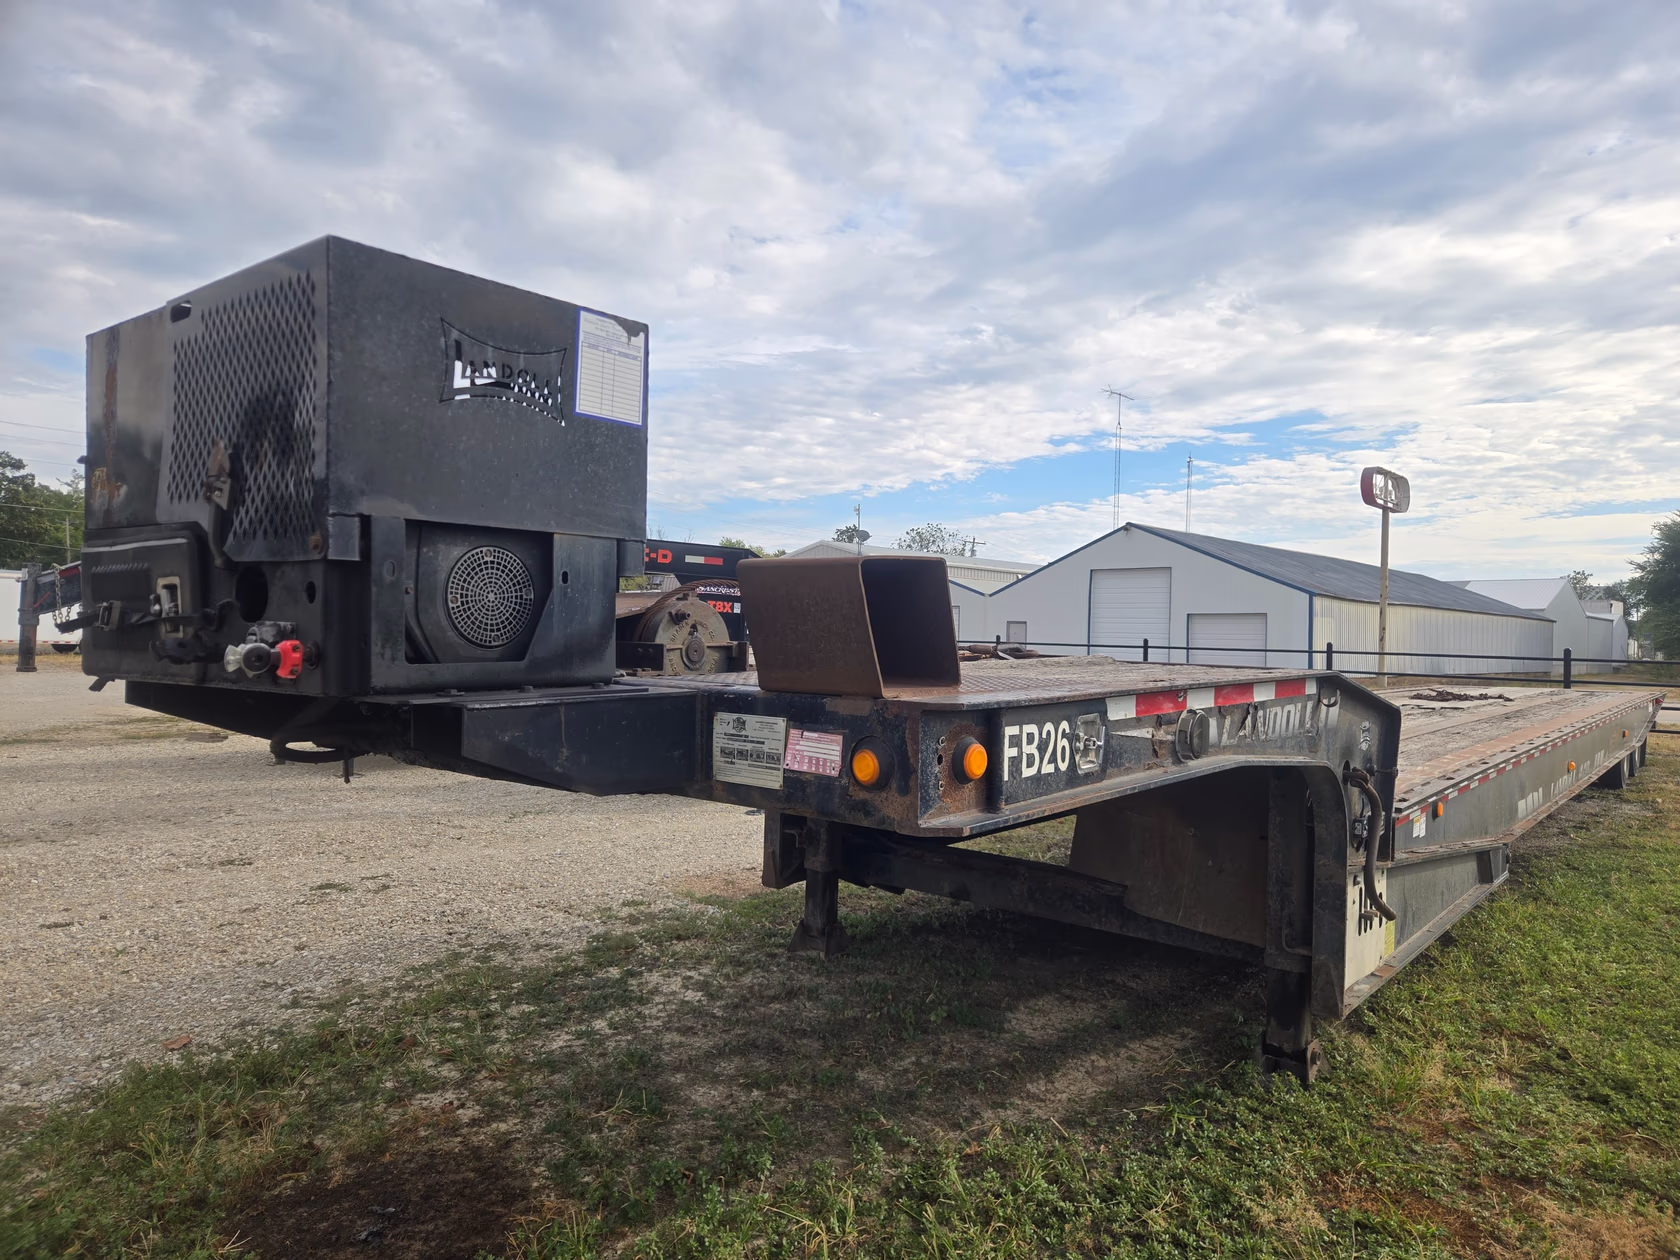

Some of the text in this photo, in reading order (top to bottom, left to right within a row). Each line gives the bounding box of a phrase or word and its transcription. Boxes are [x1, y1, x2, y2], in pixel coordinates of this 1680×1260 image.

[453, 339, 552, 396] LANDOLL
[706, 600, 733, 613] T8X
[1003, 720, 1071, 782] FB26
